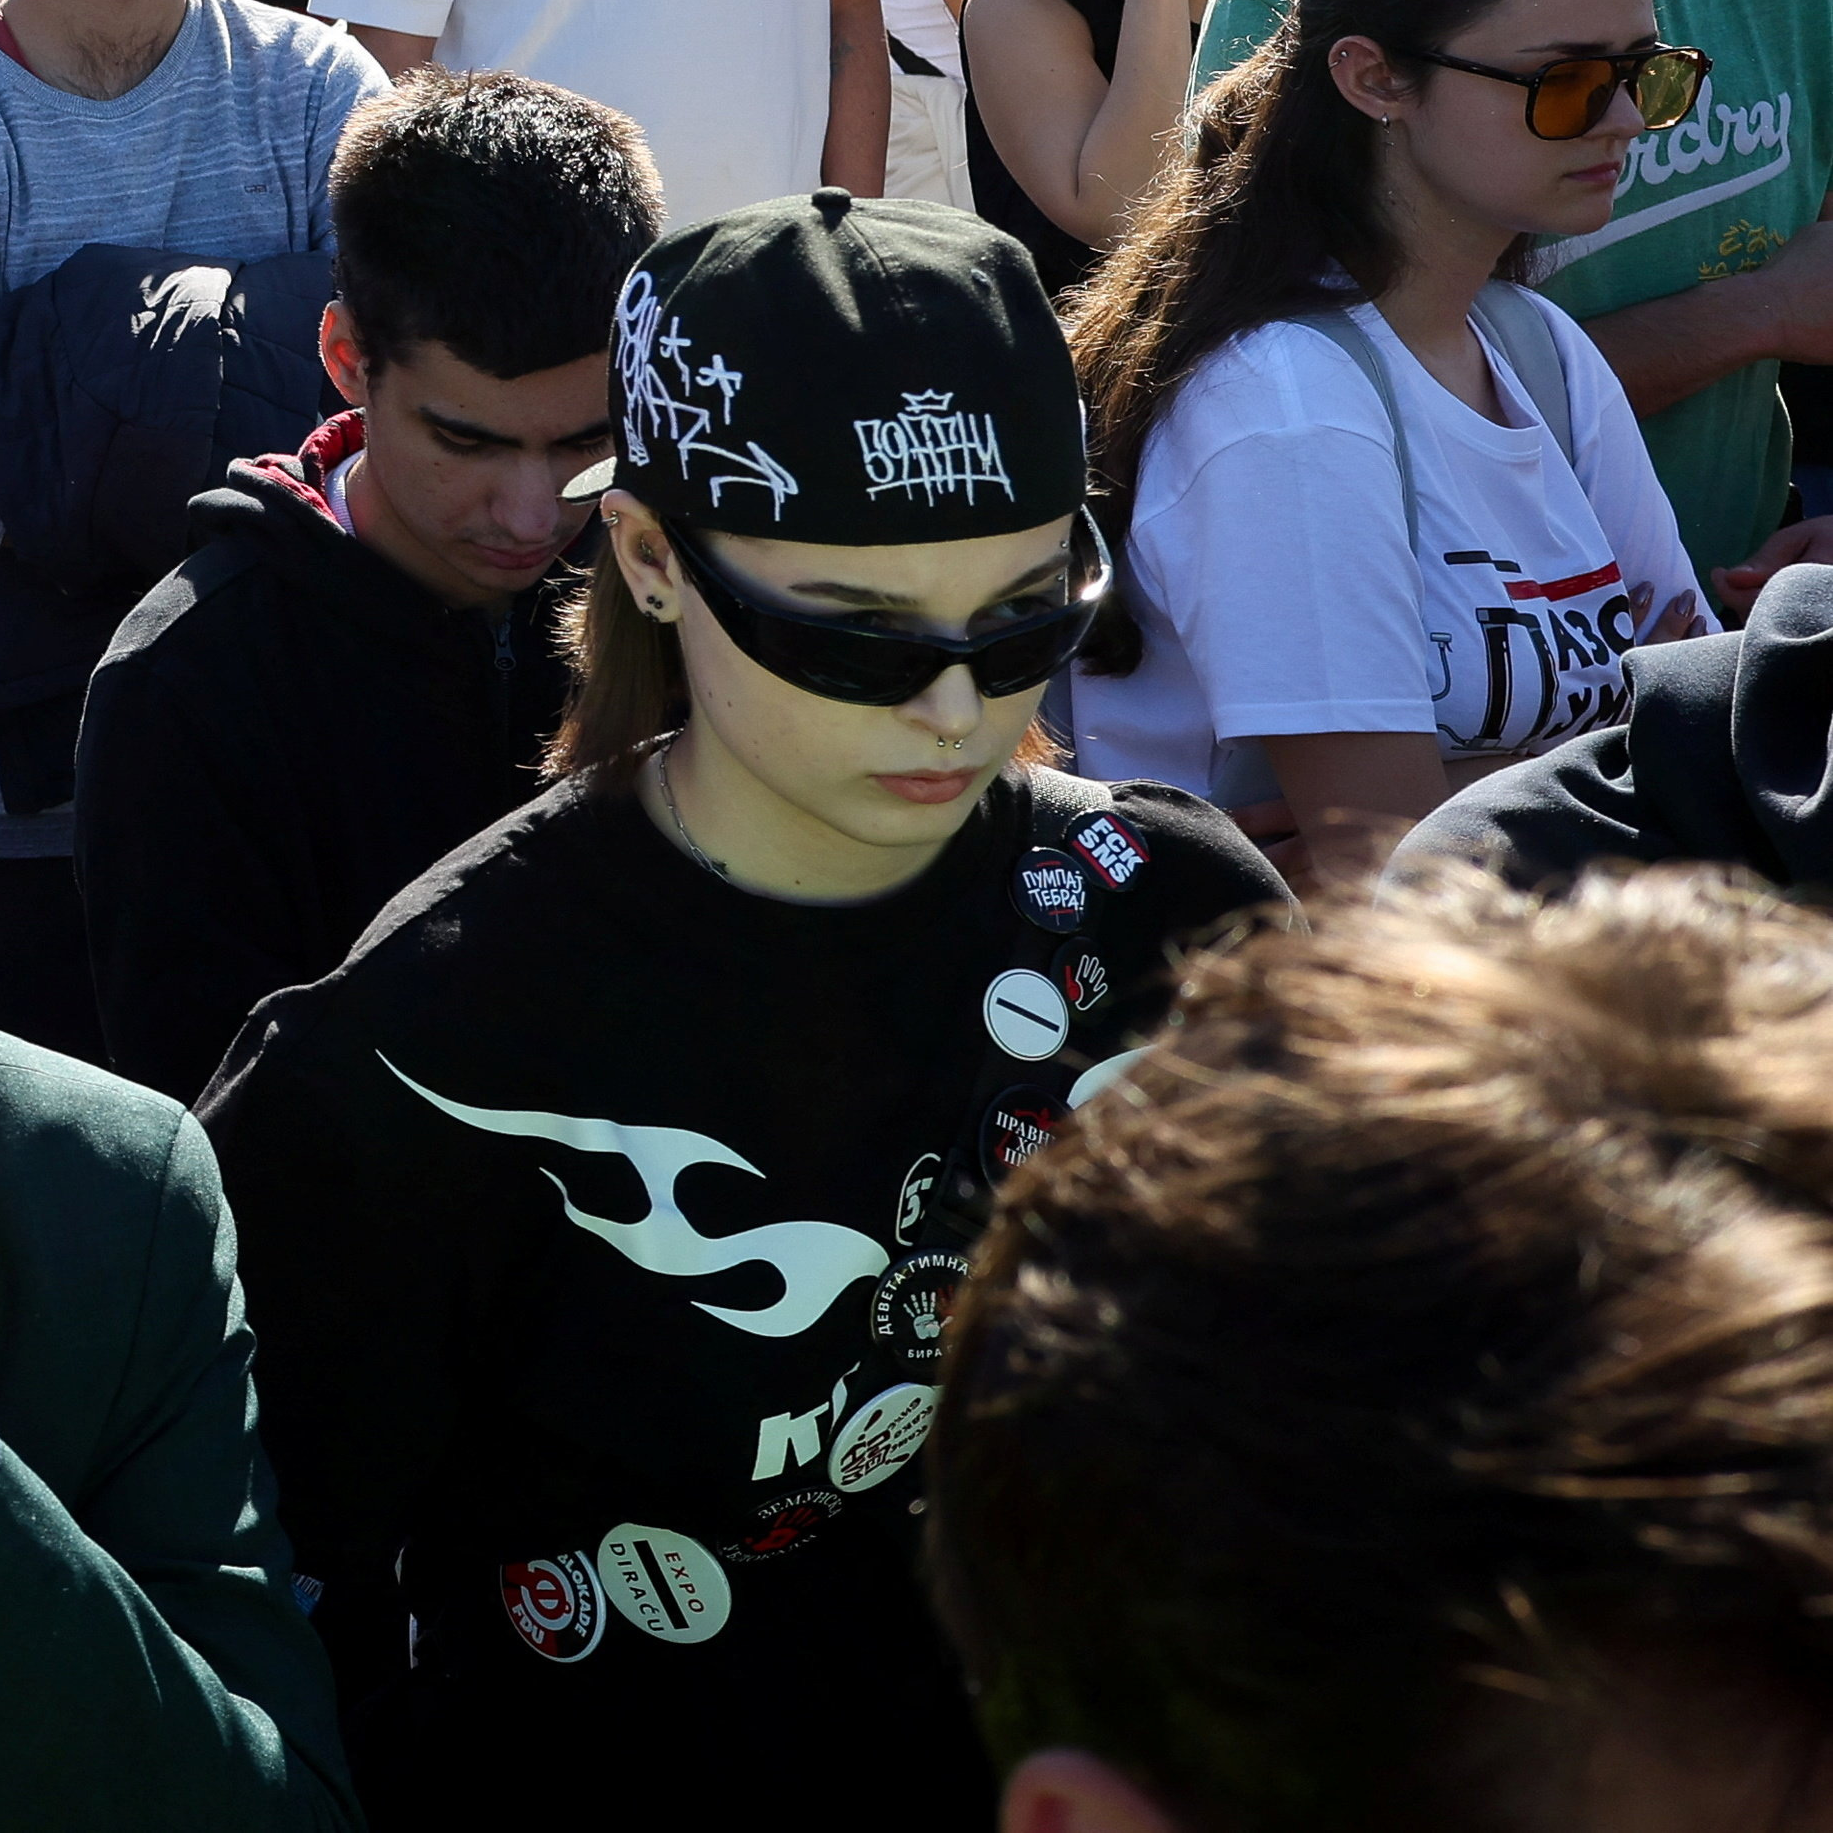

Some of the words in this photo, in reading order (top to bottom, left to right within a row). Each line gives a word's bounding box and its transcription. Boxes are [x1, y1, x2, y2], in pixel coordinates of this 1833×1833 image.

[1077, 828, 1131, 883] SNS
[1091, 818, 1144, 872] FCK
[1021, 868, 1084, 894] ПУМПАЈ
[1027, 888, 1086, 910] ТЕБРА!
[995, 1110, 1056, 1145] ПРАВН
[1015, 1136, 1045, 1155] ХО
[1003, 1146, 1031, 1168] ПР
[878, 1271, 906, 1336] ДЕВЕТА
[908, 1254, 975, 1281] ГИМНА
[907, 1348, 943, 1359] БИРА
[609, 1542, 665, 1634] DIRAĆU
[664, 1551, 705, 1615] EXPO
[511, 1604, 546, 1646] FDU
